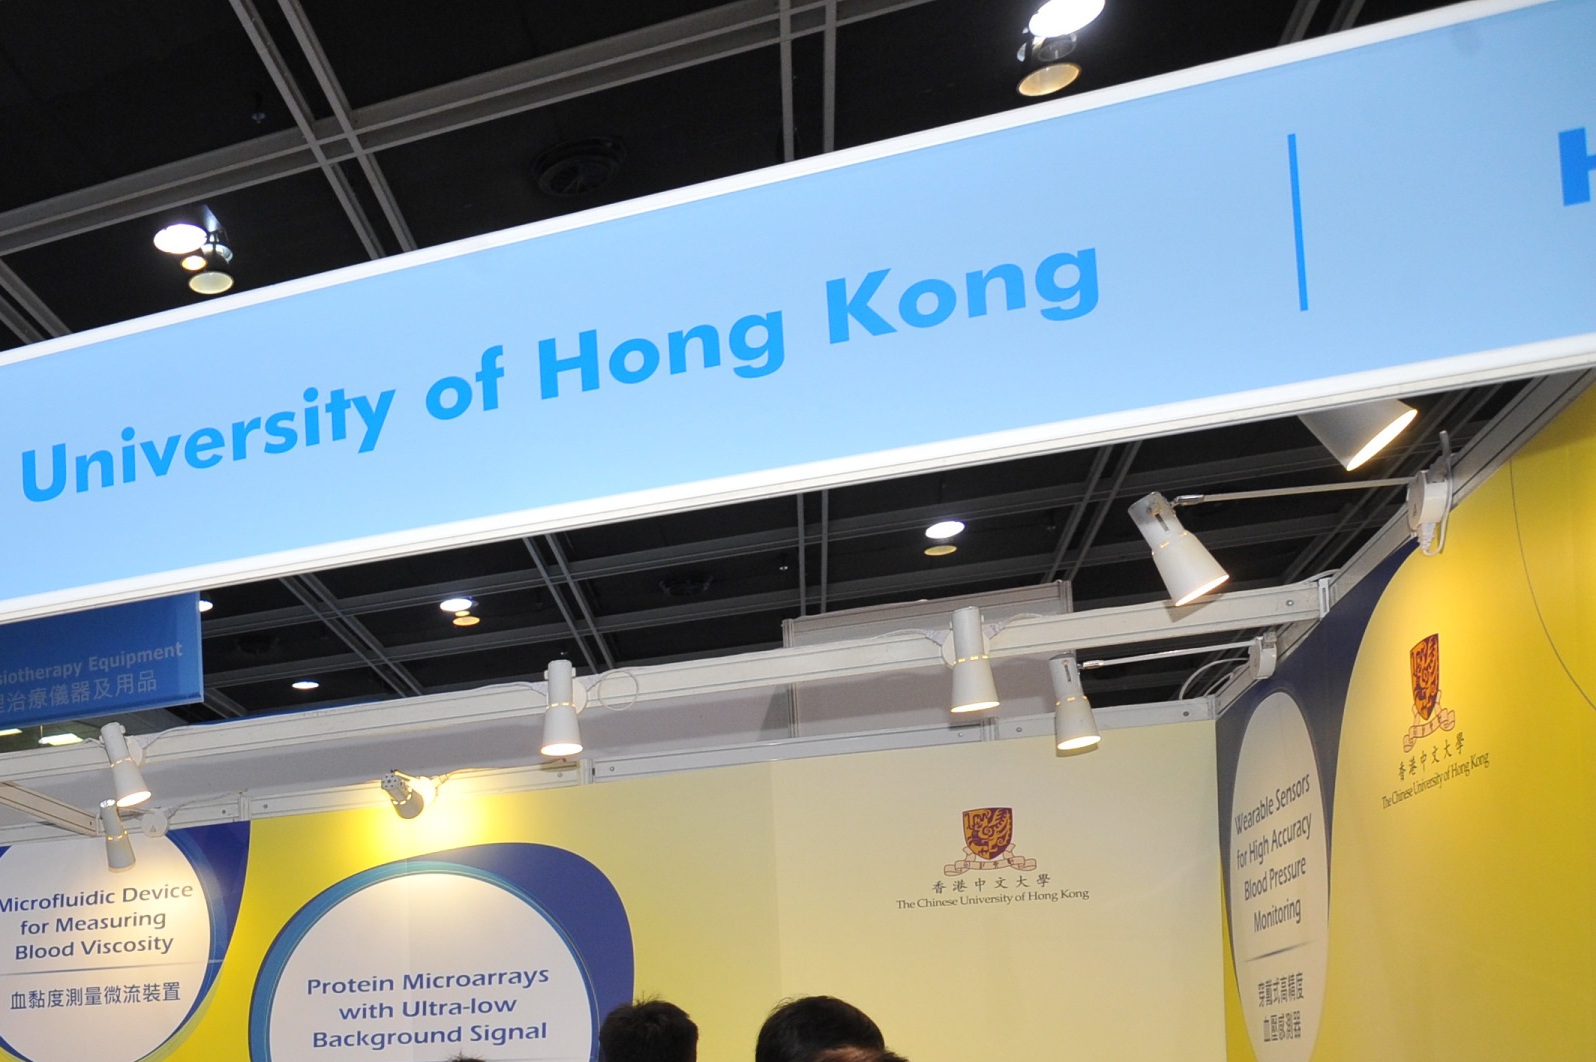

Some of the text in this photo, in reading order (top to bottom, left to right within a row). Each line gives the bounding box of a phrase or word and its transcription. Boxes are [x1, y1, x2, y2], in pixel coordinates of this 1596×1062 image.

[1558, 126, 1596, 206] H
[21, 386, 397, 504] University
[426, 345, 507, 419] of
[538, 309, 784, 400] Hong
[826, 246, 1099, 346] Kong
[88, 641, 183, 672] Equipment
[1235, 774, 1310, 835] Wearable Sensors
[1237, 813, 1312, 869] for High Accuracy
[123, 884, 194, 903] Device
[932, 873, 1051, 894] 香港中文大學
[1244, 857, 1306, 901] Blood Pressure
[896, 888, 1090, 909] The Chinese University of Hong Kong
[20, 912, 166, 935] for Measuring
[1254, 898, 1301, 932] Monitoring
[16, 936, 173, 960] Blood Viscosity
[307, 969, 550, 995] Protein Microarrays
[339, 997, 517, 1020] with Ultra-low
[313, 1022, 547, 1051] Background Signal
